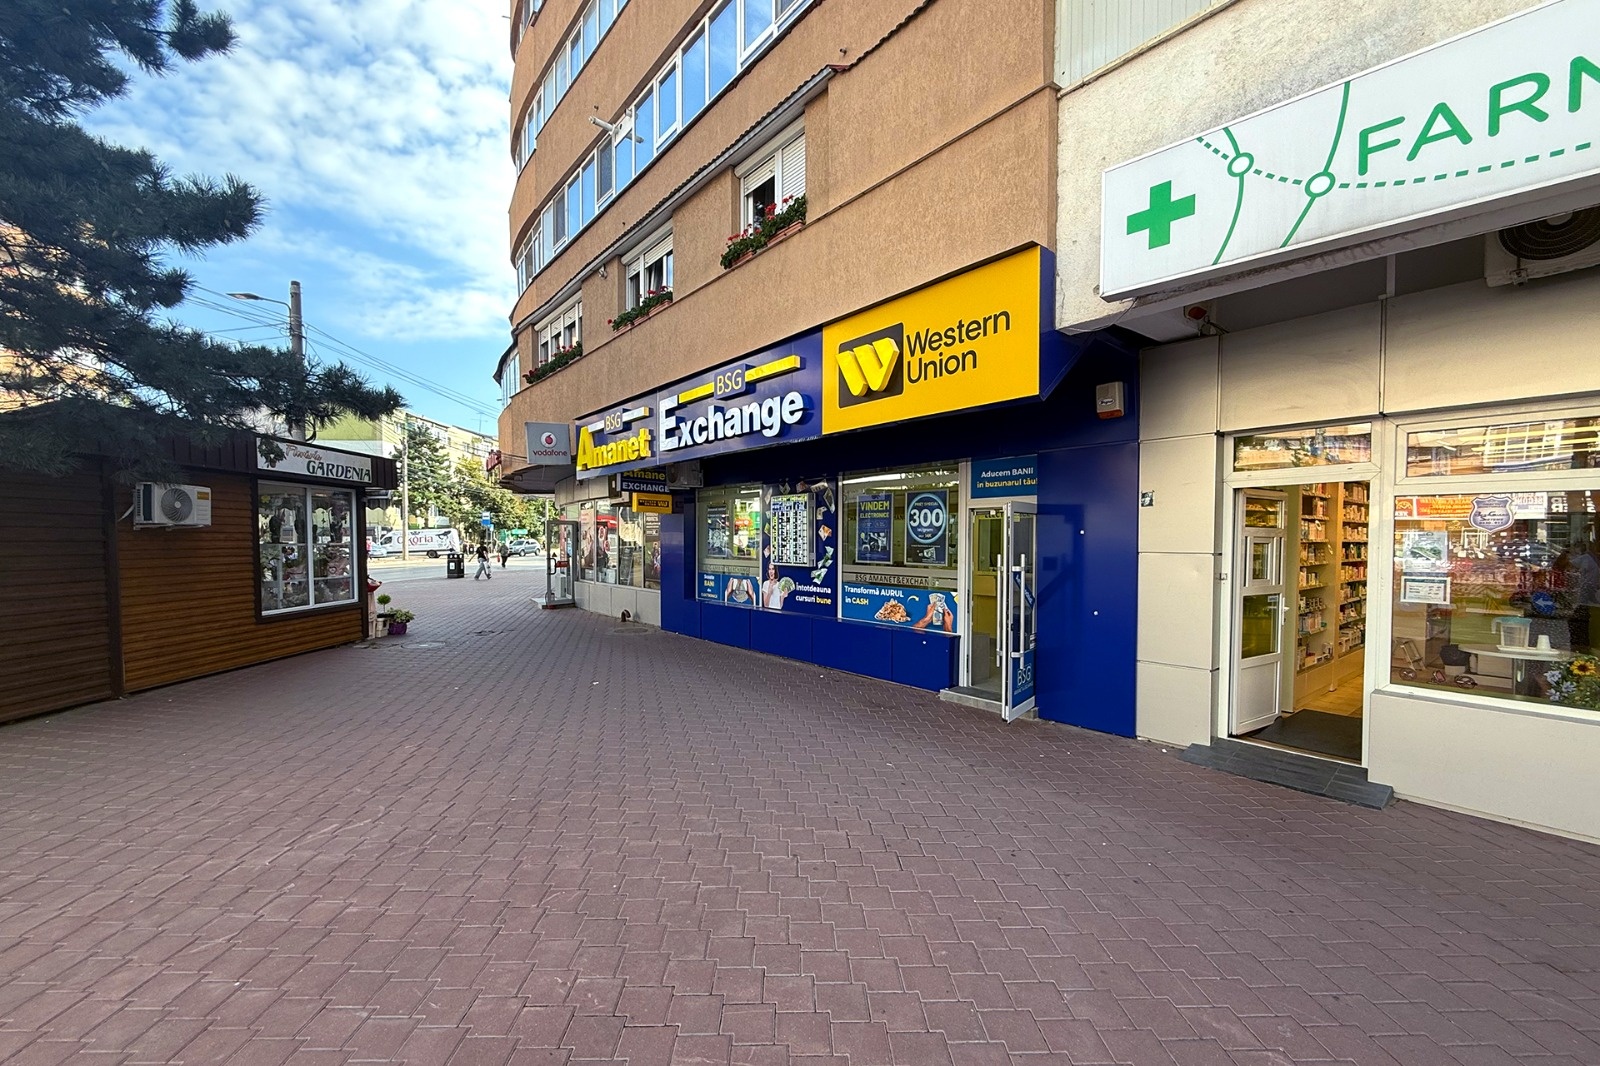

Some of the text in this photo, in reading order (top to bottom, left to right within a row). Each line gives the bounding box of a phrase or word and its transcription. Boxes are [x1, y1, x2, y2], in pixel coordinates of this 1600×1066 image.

[907, 310, 1010, 357] Western
[907, 350, 977, 384] Union
[716, 369, 742, 395] BSG
[604, 411, 621, 432] BSG
[659, 391, 804, 451] Exchange
[532, 449, 568, 457] vodafone
[576, 424, 652, 471] Amanet
[306, 460, 371, 482] GARDENIA
[981, 467, 1034, 478] Aducem BANII
[622, 481, 670, 493] EXCHANGE
[985, 478, 1022, 488] buzunarul
[860, 500, 890, 511] VINDEM
[910, 508, 943, 527] 300
[795, 595, 831, 604] cursuri bune
[844, 585, 904, 598] Transformă AURUL
[852, 597, 869, 605] CASH
[1017, 665, 1031, 686] BSG
